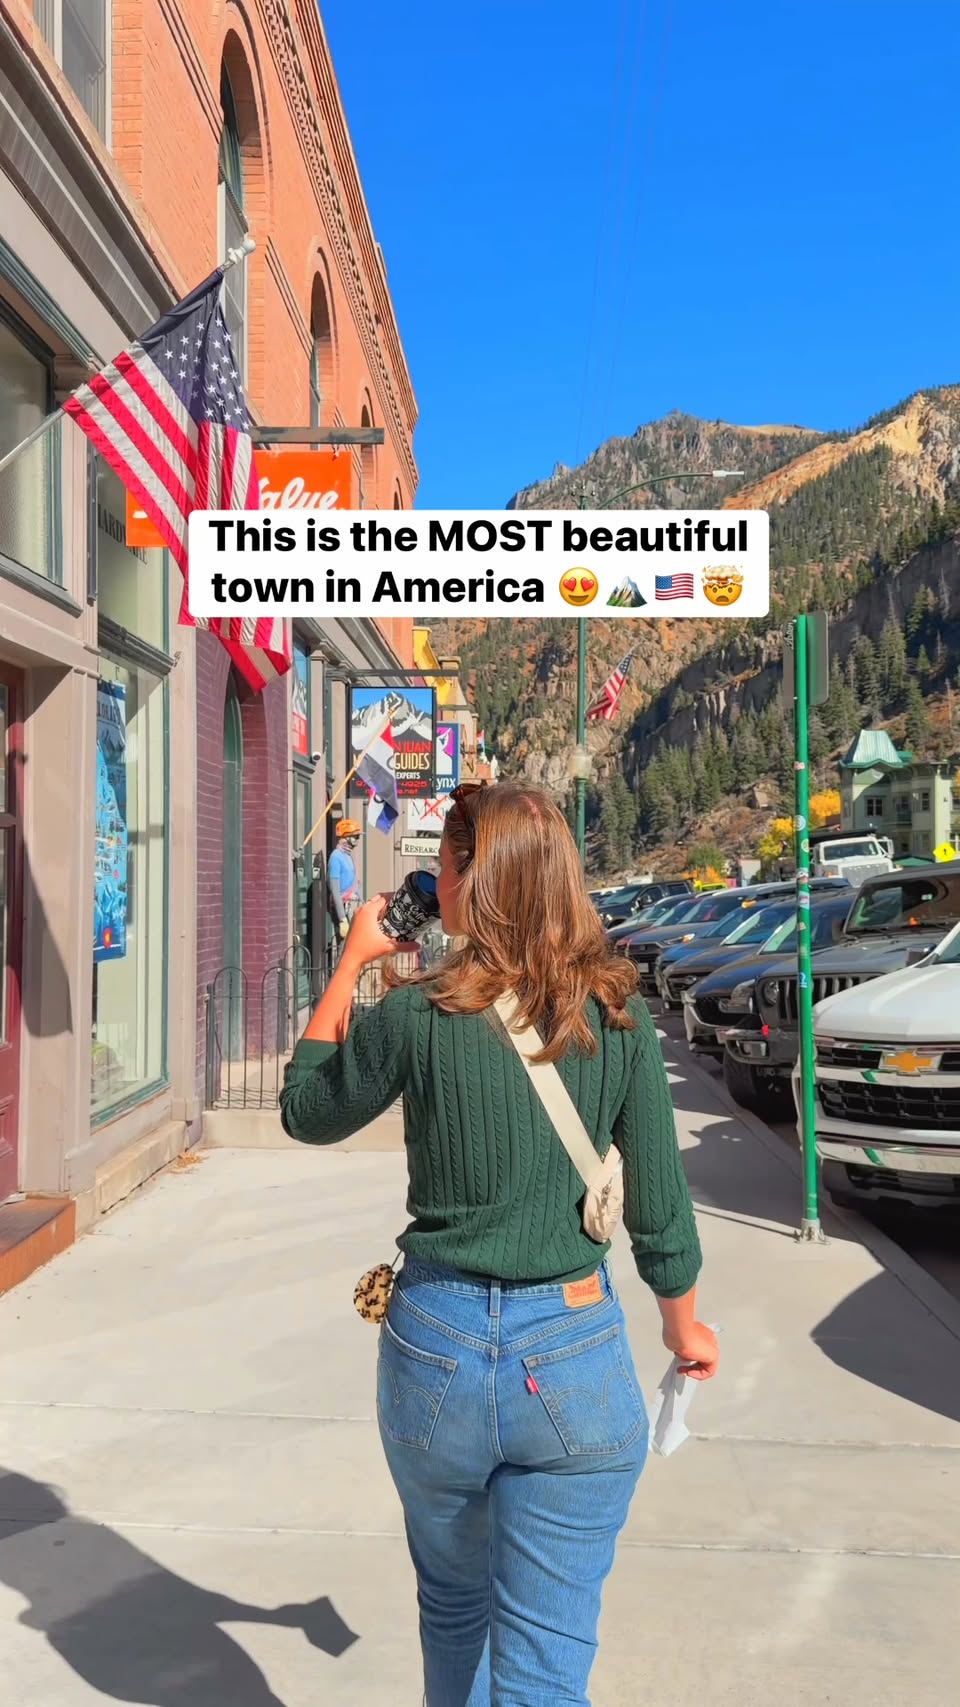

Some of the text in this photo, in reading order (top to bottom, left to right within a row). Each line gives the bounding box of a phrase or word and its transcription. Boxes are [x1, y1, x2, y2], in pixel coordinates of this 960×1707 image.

[259, 477, 339, 510] alue
[394, 752, 430, 769] GUIDES
[436, 778, 455, 790] ynx
[405, 843, 438, 854] RESEARC
